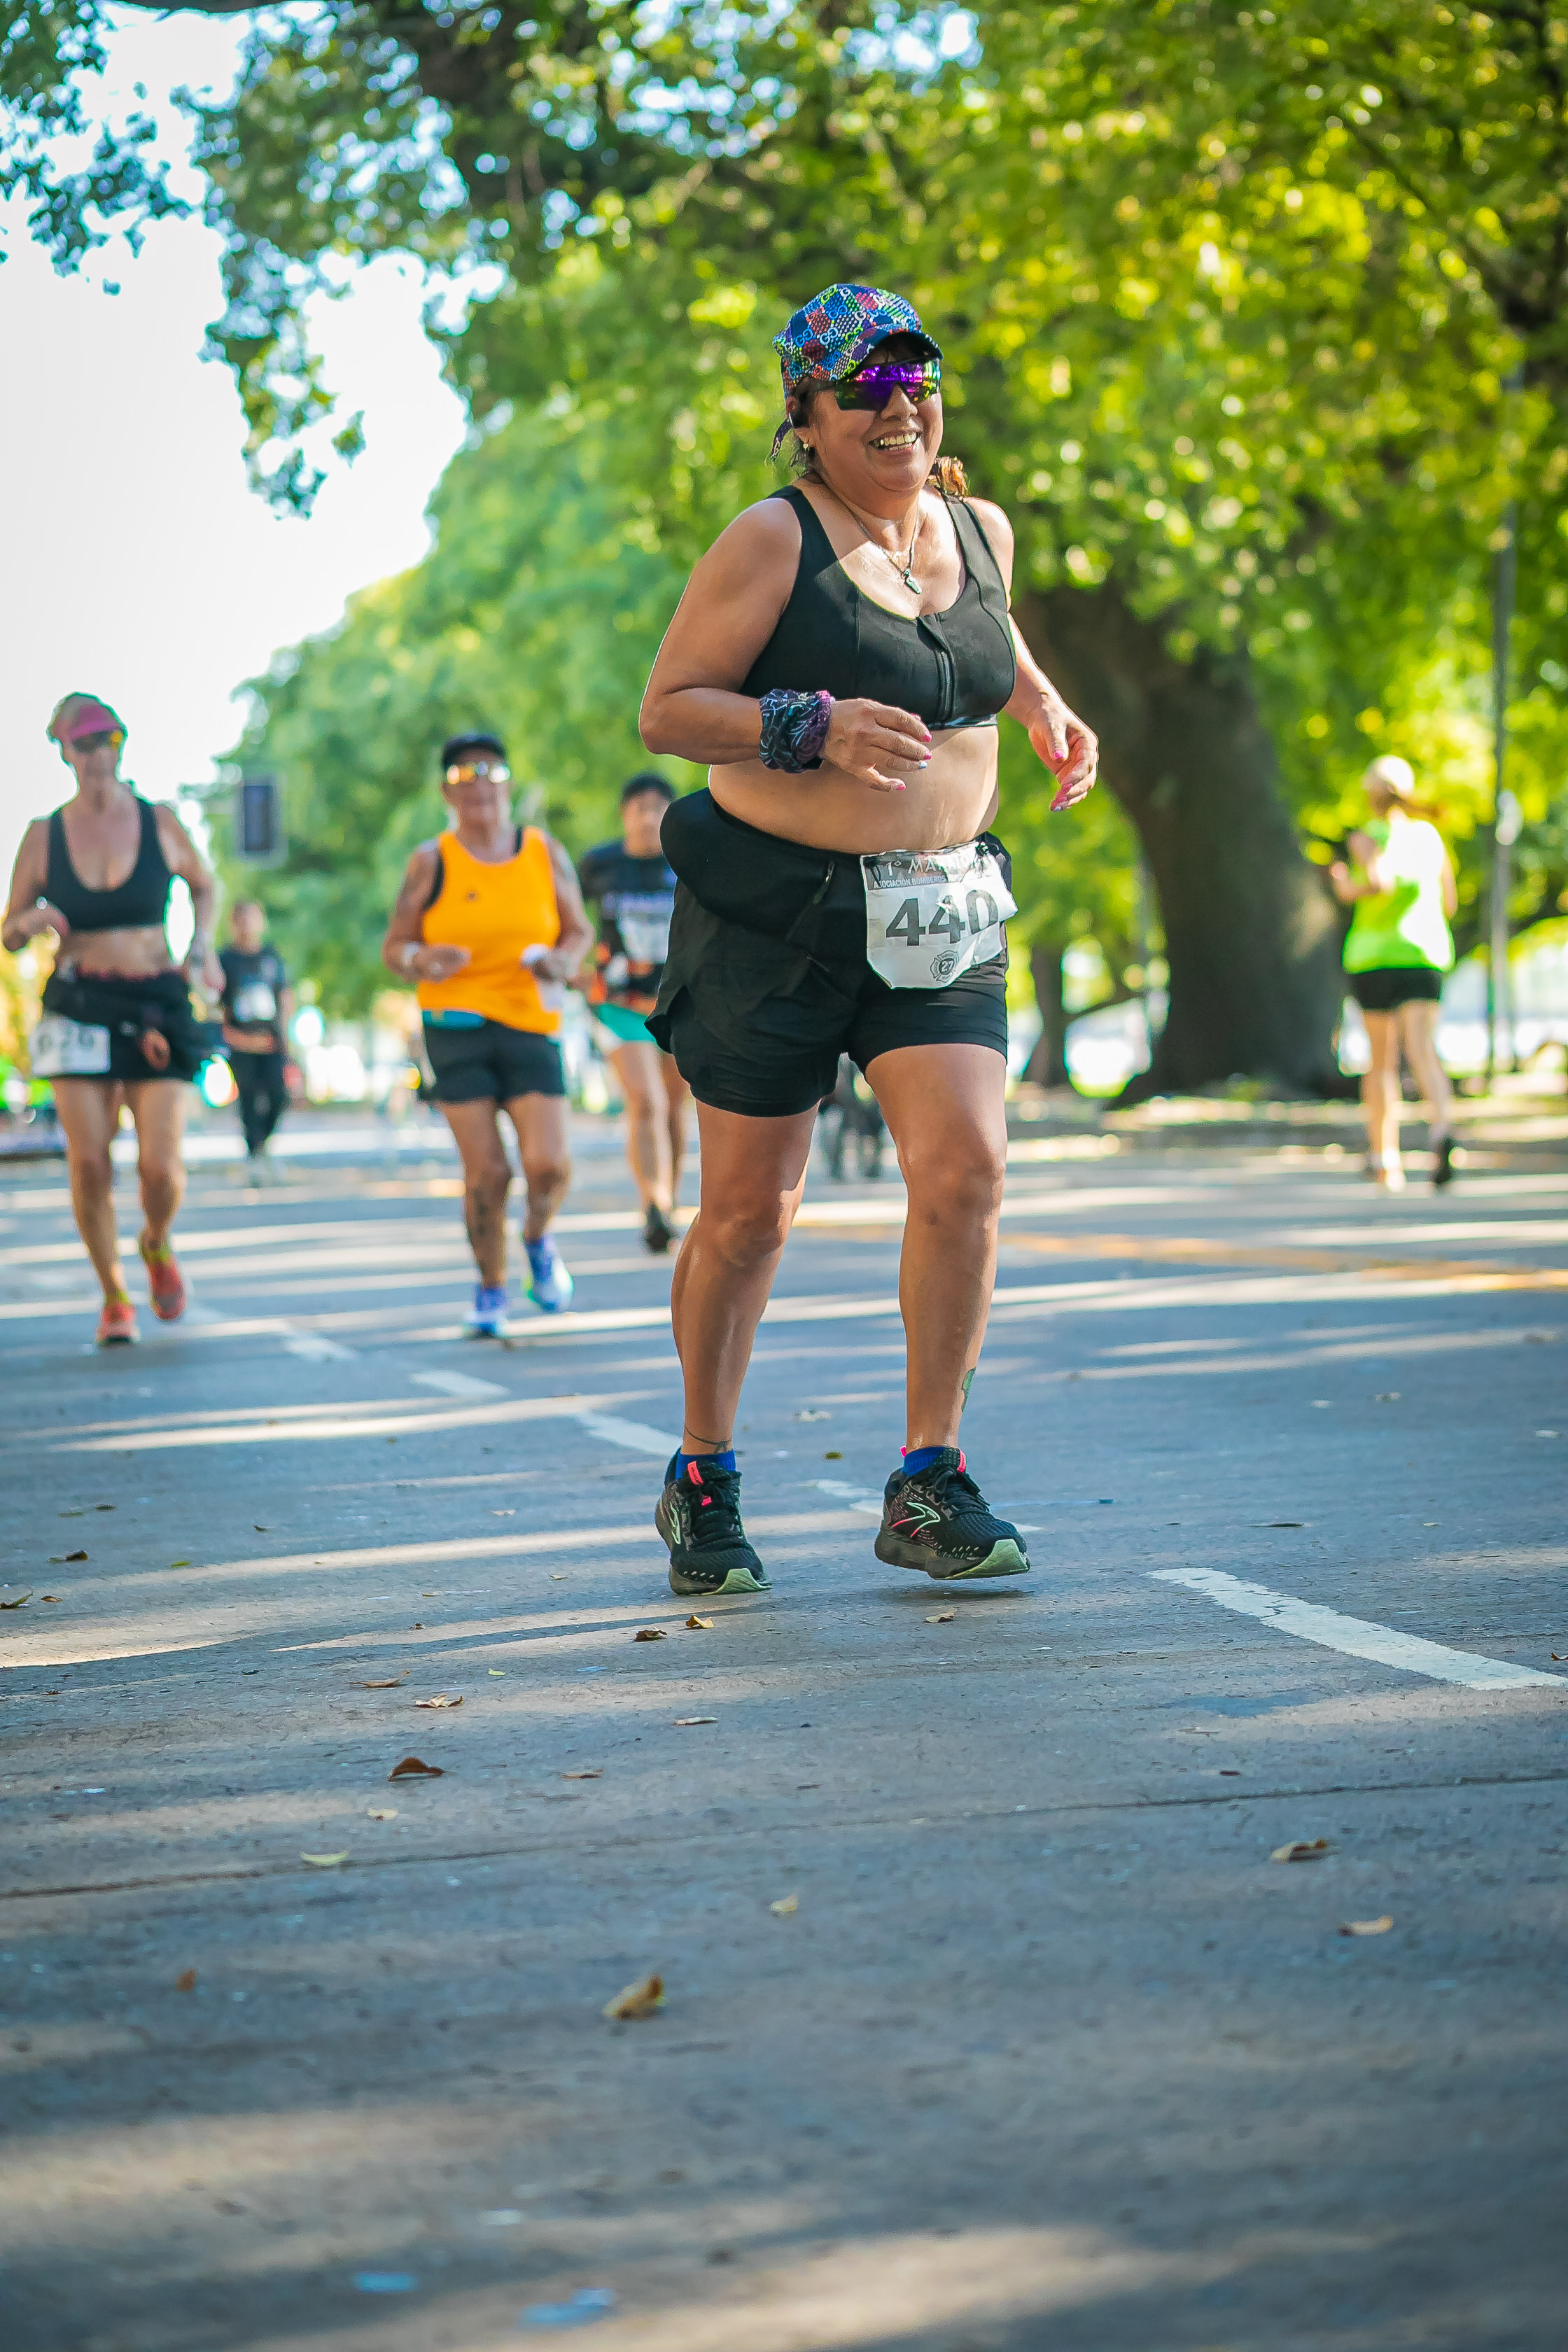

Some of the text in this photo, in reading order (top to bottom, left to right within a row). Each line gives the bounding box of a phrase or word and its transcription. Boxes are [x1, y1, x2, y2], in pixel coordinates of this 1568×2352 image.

[911, 875, 947, 886] BOMBEROS
[886, 890, 999, 946] 440
[941, 960, 954, 972] 27
